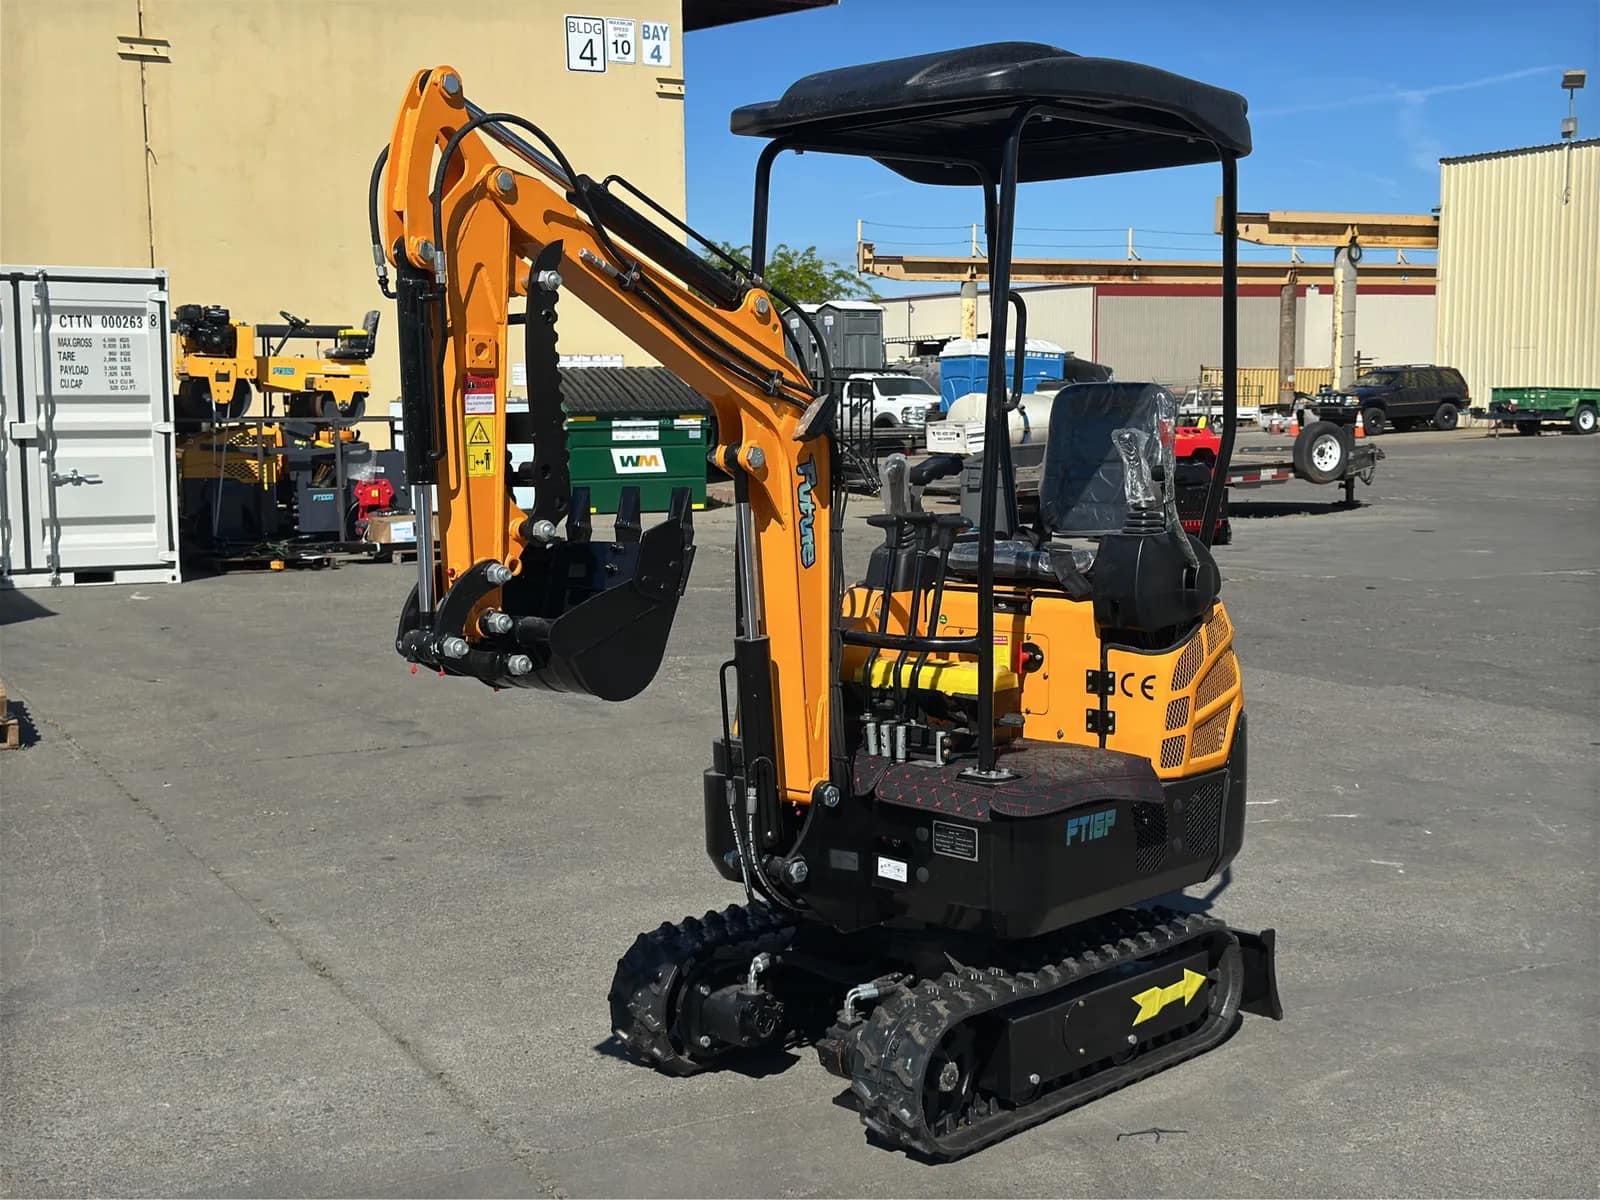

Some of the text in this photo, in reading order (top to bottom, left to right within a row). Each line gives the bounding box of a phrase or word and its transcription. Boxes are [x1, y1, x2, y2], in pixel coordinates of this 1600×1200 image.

[568, 21, 602, 35] BLDG
[642, 24, 668, 41] BAY
[579, 38, 598, 67] 4
[612, 39, 631, 56] 10
[650, 44, 662, 63] 4
[59, 313, 157, 329] CTTN 000263 8
[57, 351, 76, 361] TARE
[60, 364, 90, 375] PAYLOAD
[619, 455, 660, 468] WM
[1120, 672, 1157, 701] CE
